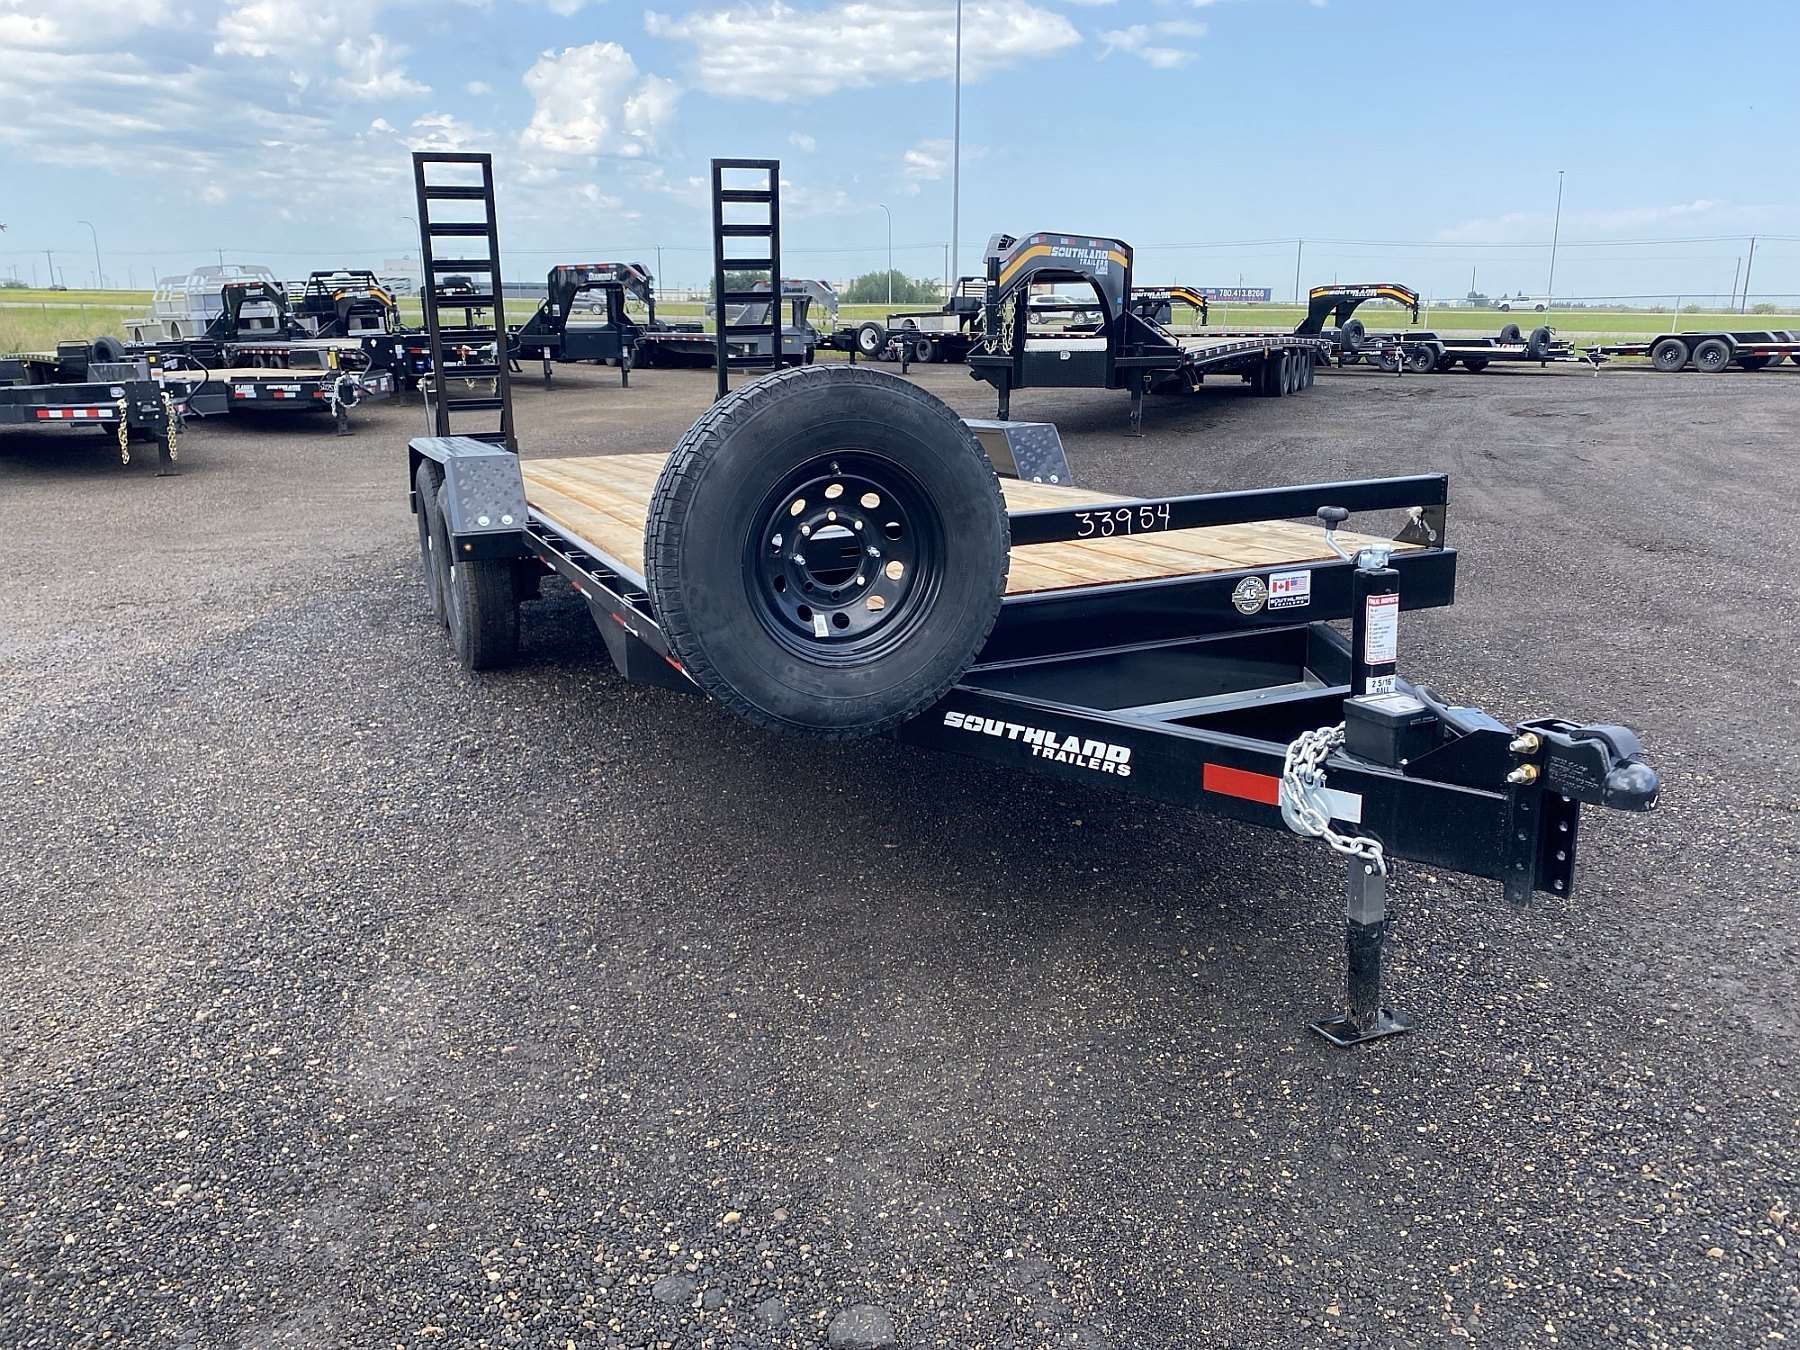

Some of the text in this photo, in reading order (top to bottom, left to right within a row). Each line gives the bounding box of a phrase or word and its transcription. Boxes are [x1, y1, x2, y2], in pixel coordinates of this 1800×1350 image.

[1050, 246, 1109, 260] SOUTHLAND
[1075, 503, 1170, 536] 33954
[1243, 589, 1257, 600] 45
[1371, 680, 1378, 688] 2
[943, 711, 1132, 765] SOUTHLAND
[1031, 744, 1132, 777] TRAILERS
